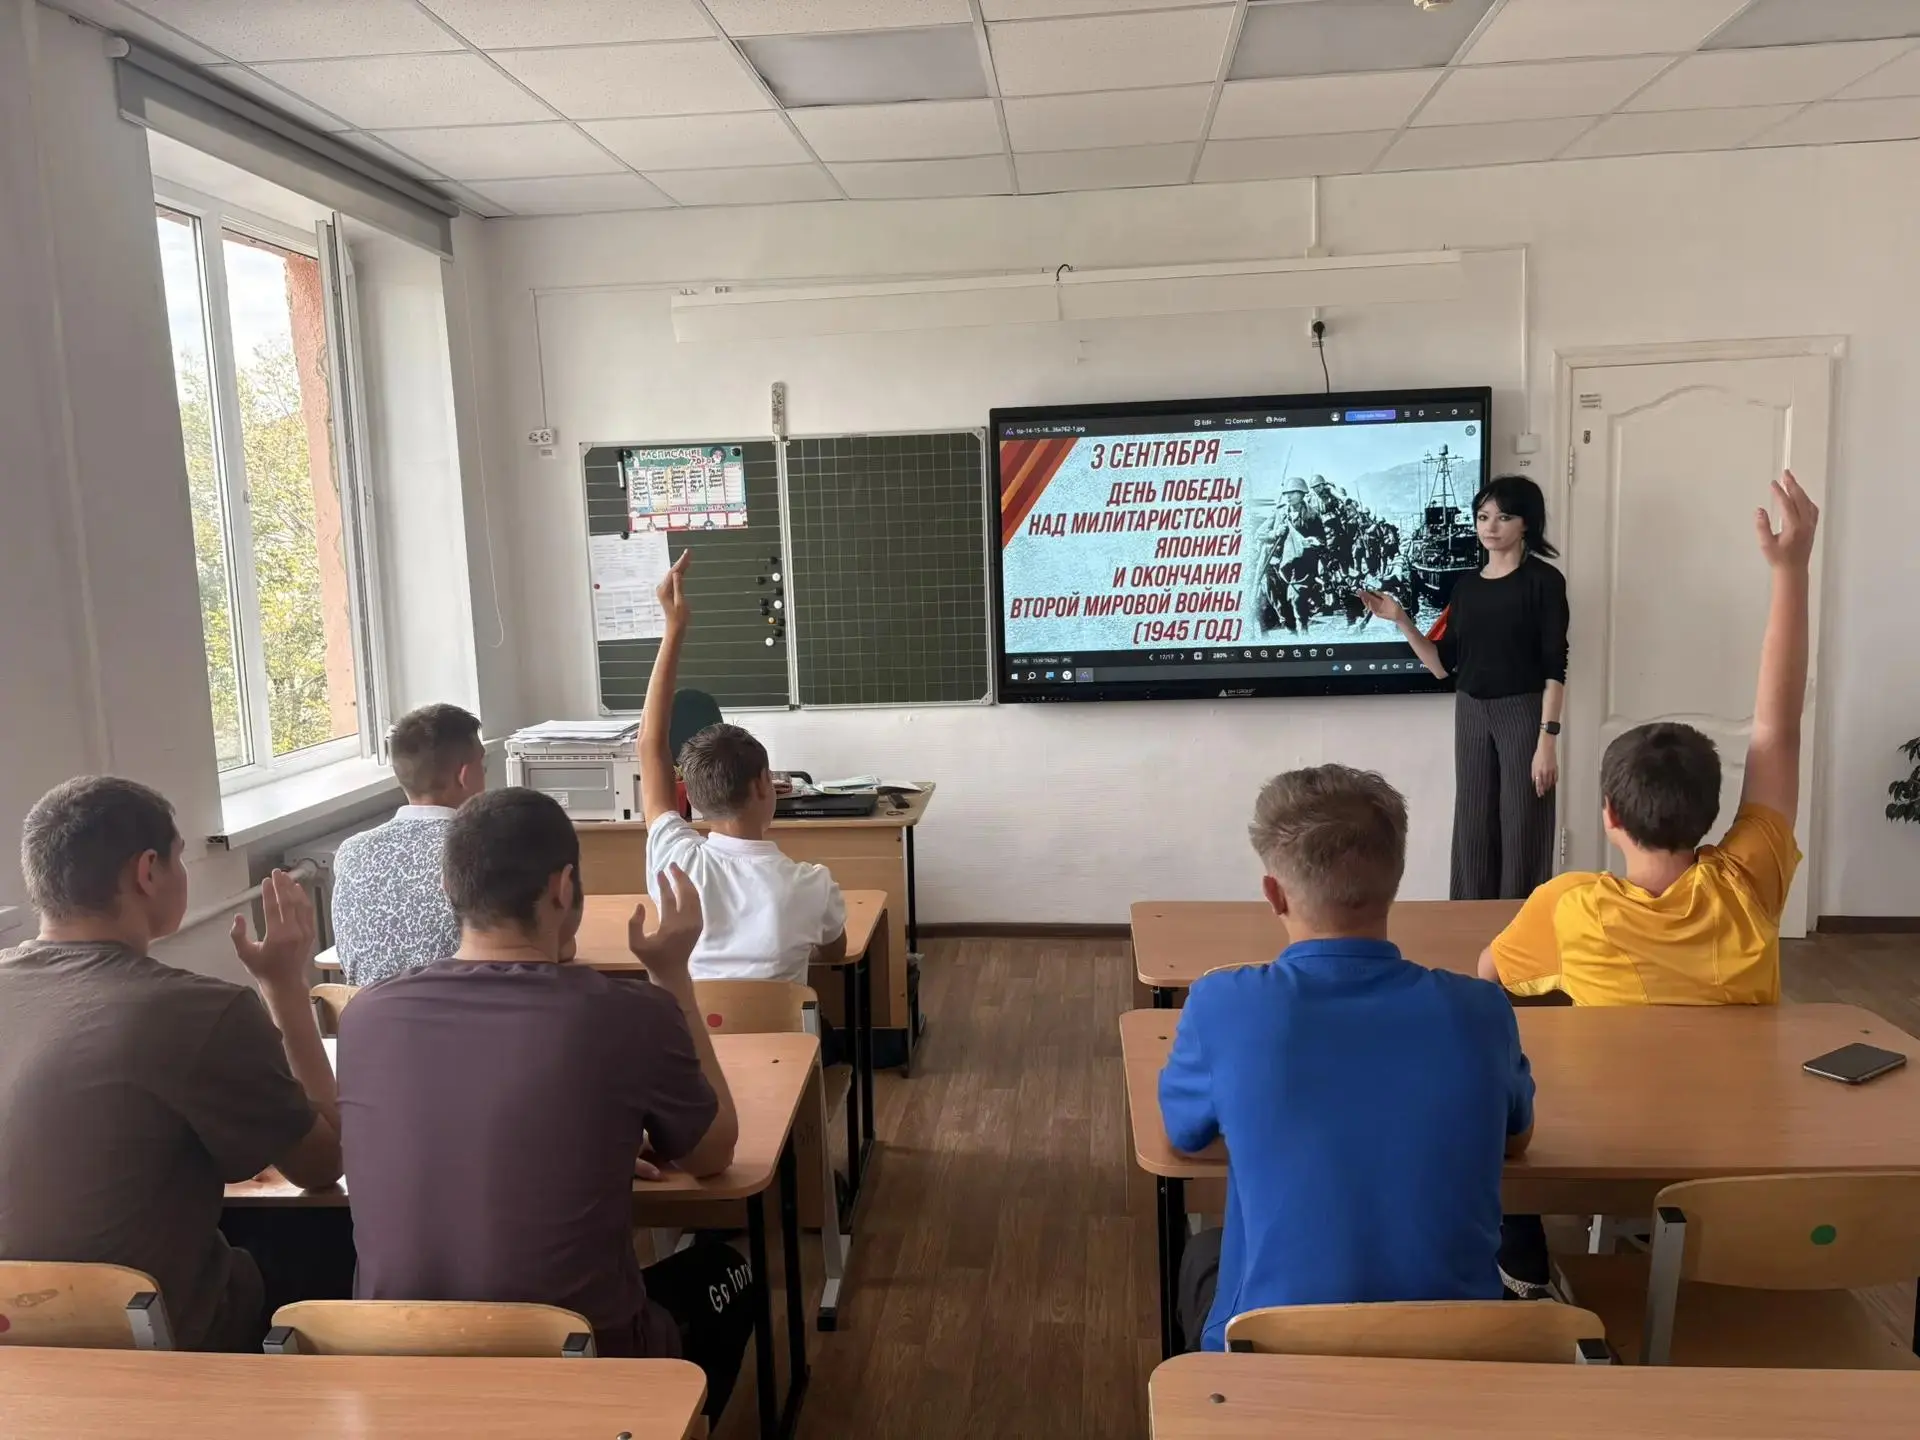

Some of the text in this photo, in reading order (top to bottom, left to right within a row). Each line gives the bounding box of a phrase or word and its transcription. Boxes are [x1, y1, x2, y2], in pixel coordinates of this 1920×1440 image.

[1232, 417, 1254, 425] Convert
[640, 448, 702, 460] РАСПИСАНИЕ
[1090, 443, 1106, 470] 3
[1109, 438, 1221, 469] СЕНТЯБРЯ
[1105, 477, 1243, 507] ДЕНЬ ПОБЕДЫ
[1027, 501, 1243, 537] НАД МИЛИТАРИСТСКОЙ
[1154, 529, 1243, 559] ЯПОНИЕЙ
[1112, 562, 1243, 588] И ОКОНЧАНИЯ
[1010, 586, 1243, 619] ВТОРОЙ МИРОВОЙ ВОЙНЫ
[1133, 618, 1243, 645] (1945 ГОД)
[709, 1283, 730, 1313] Go
